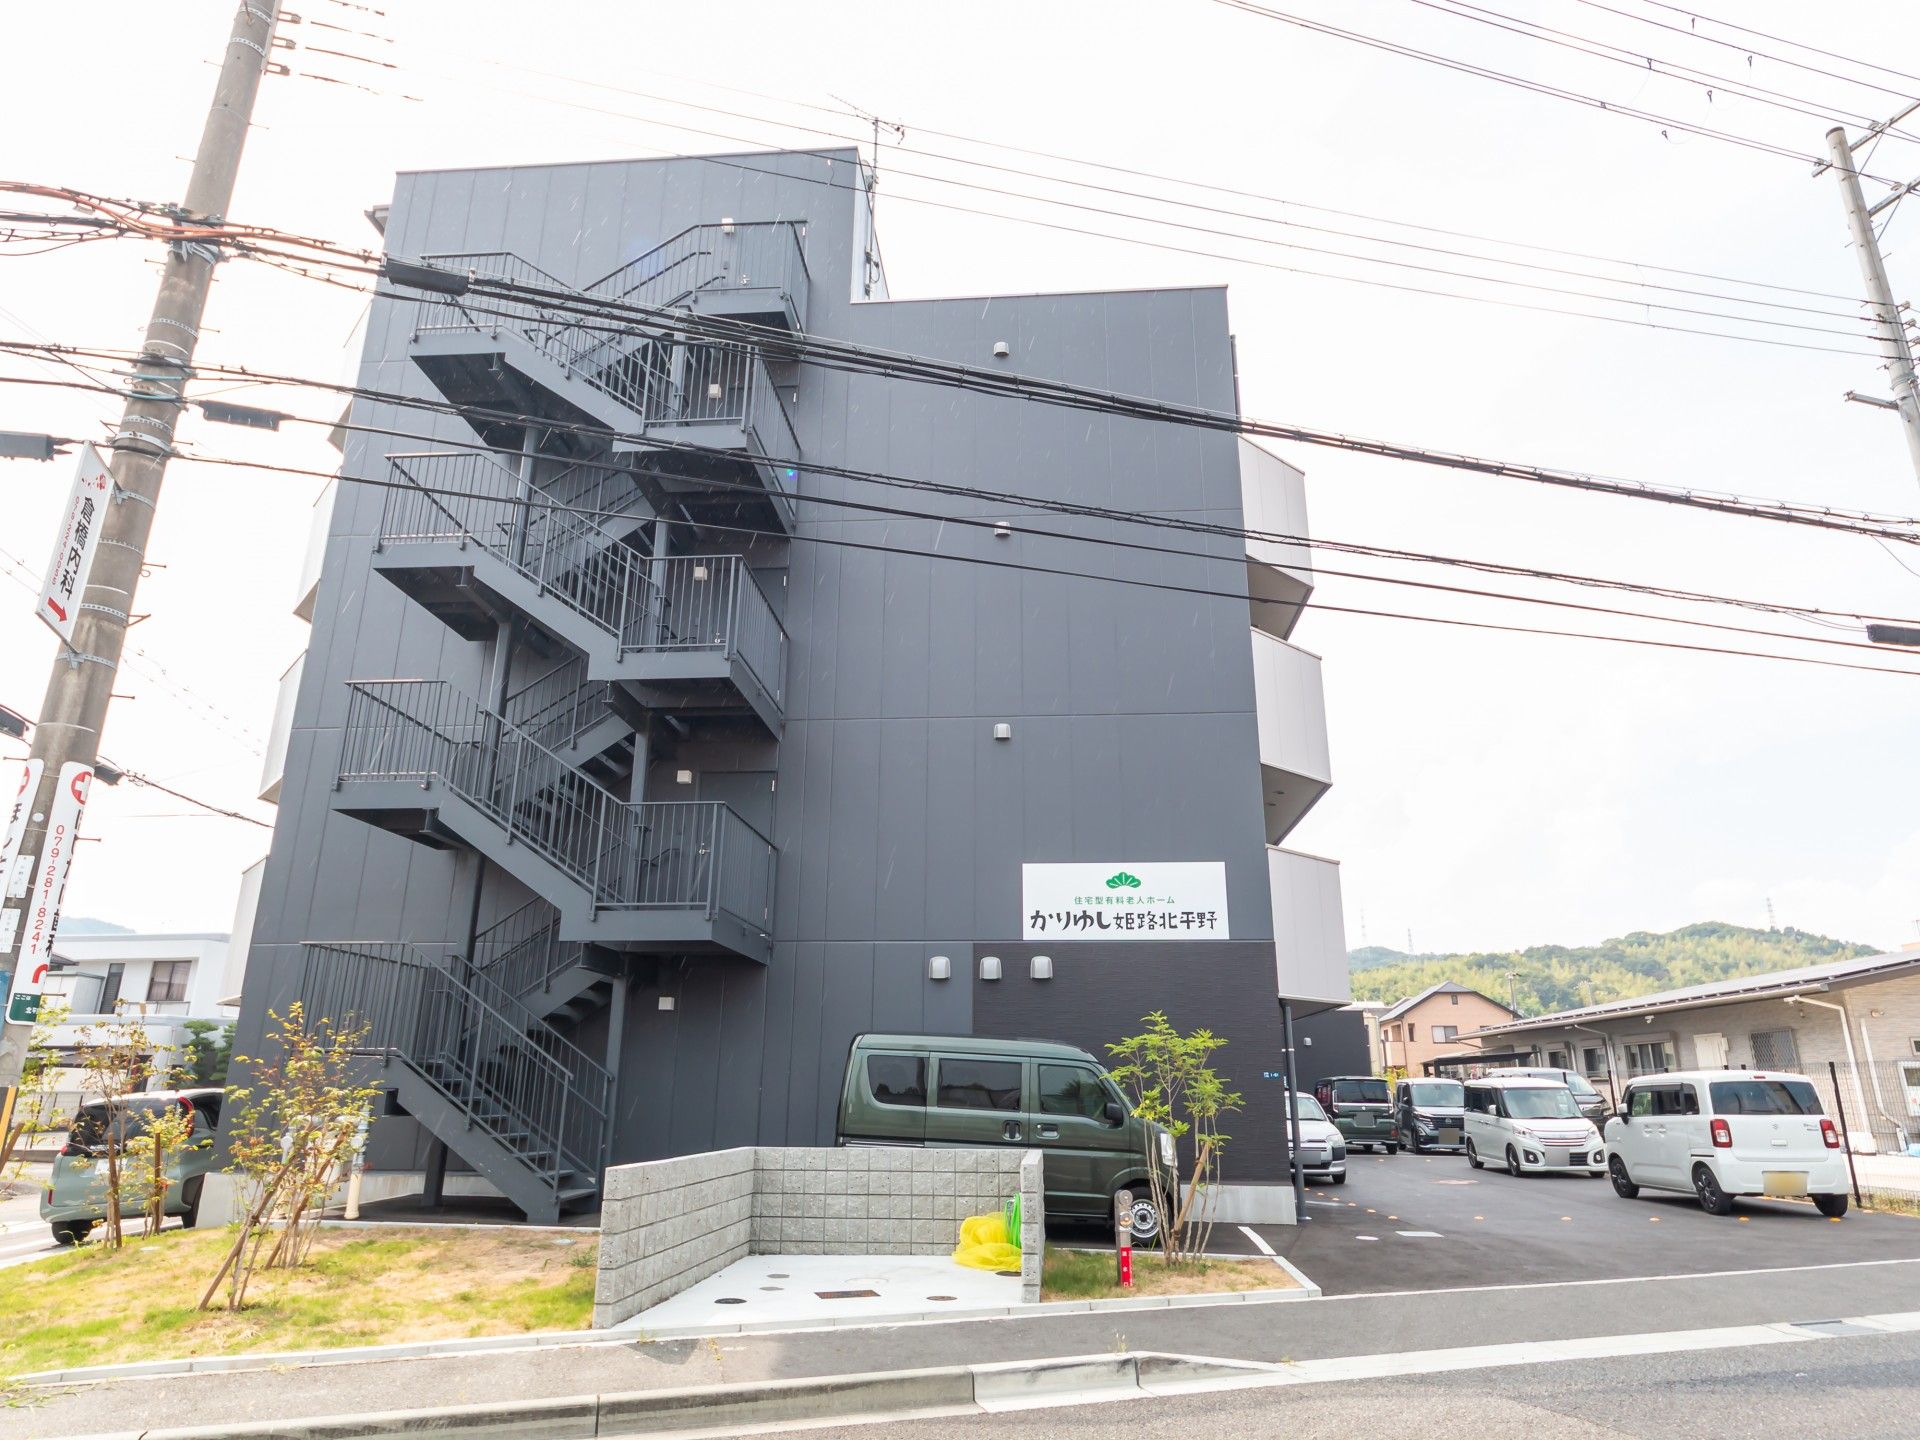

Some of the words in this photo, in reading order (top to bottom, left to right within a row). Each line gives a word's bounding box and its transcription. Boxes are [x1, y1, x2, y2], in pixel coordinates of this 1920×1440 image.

[60, 496, 95, 601] 倉橋内科
[30, 824, 65, 955] 079-281-8241
[1030, 909, 1218, 932] かりゆし姫路北平野
[1074, 895, 1176, 905] 住宅型有料老人ホーム
